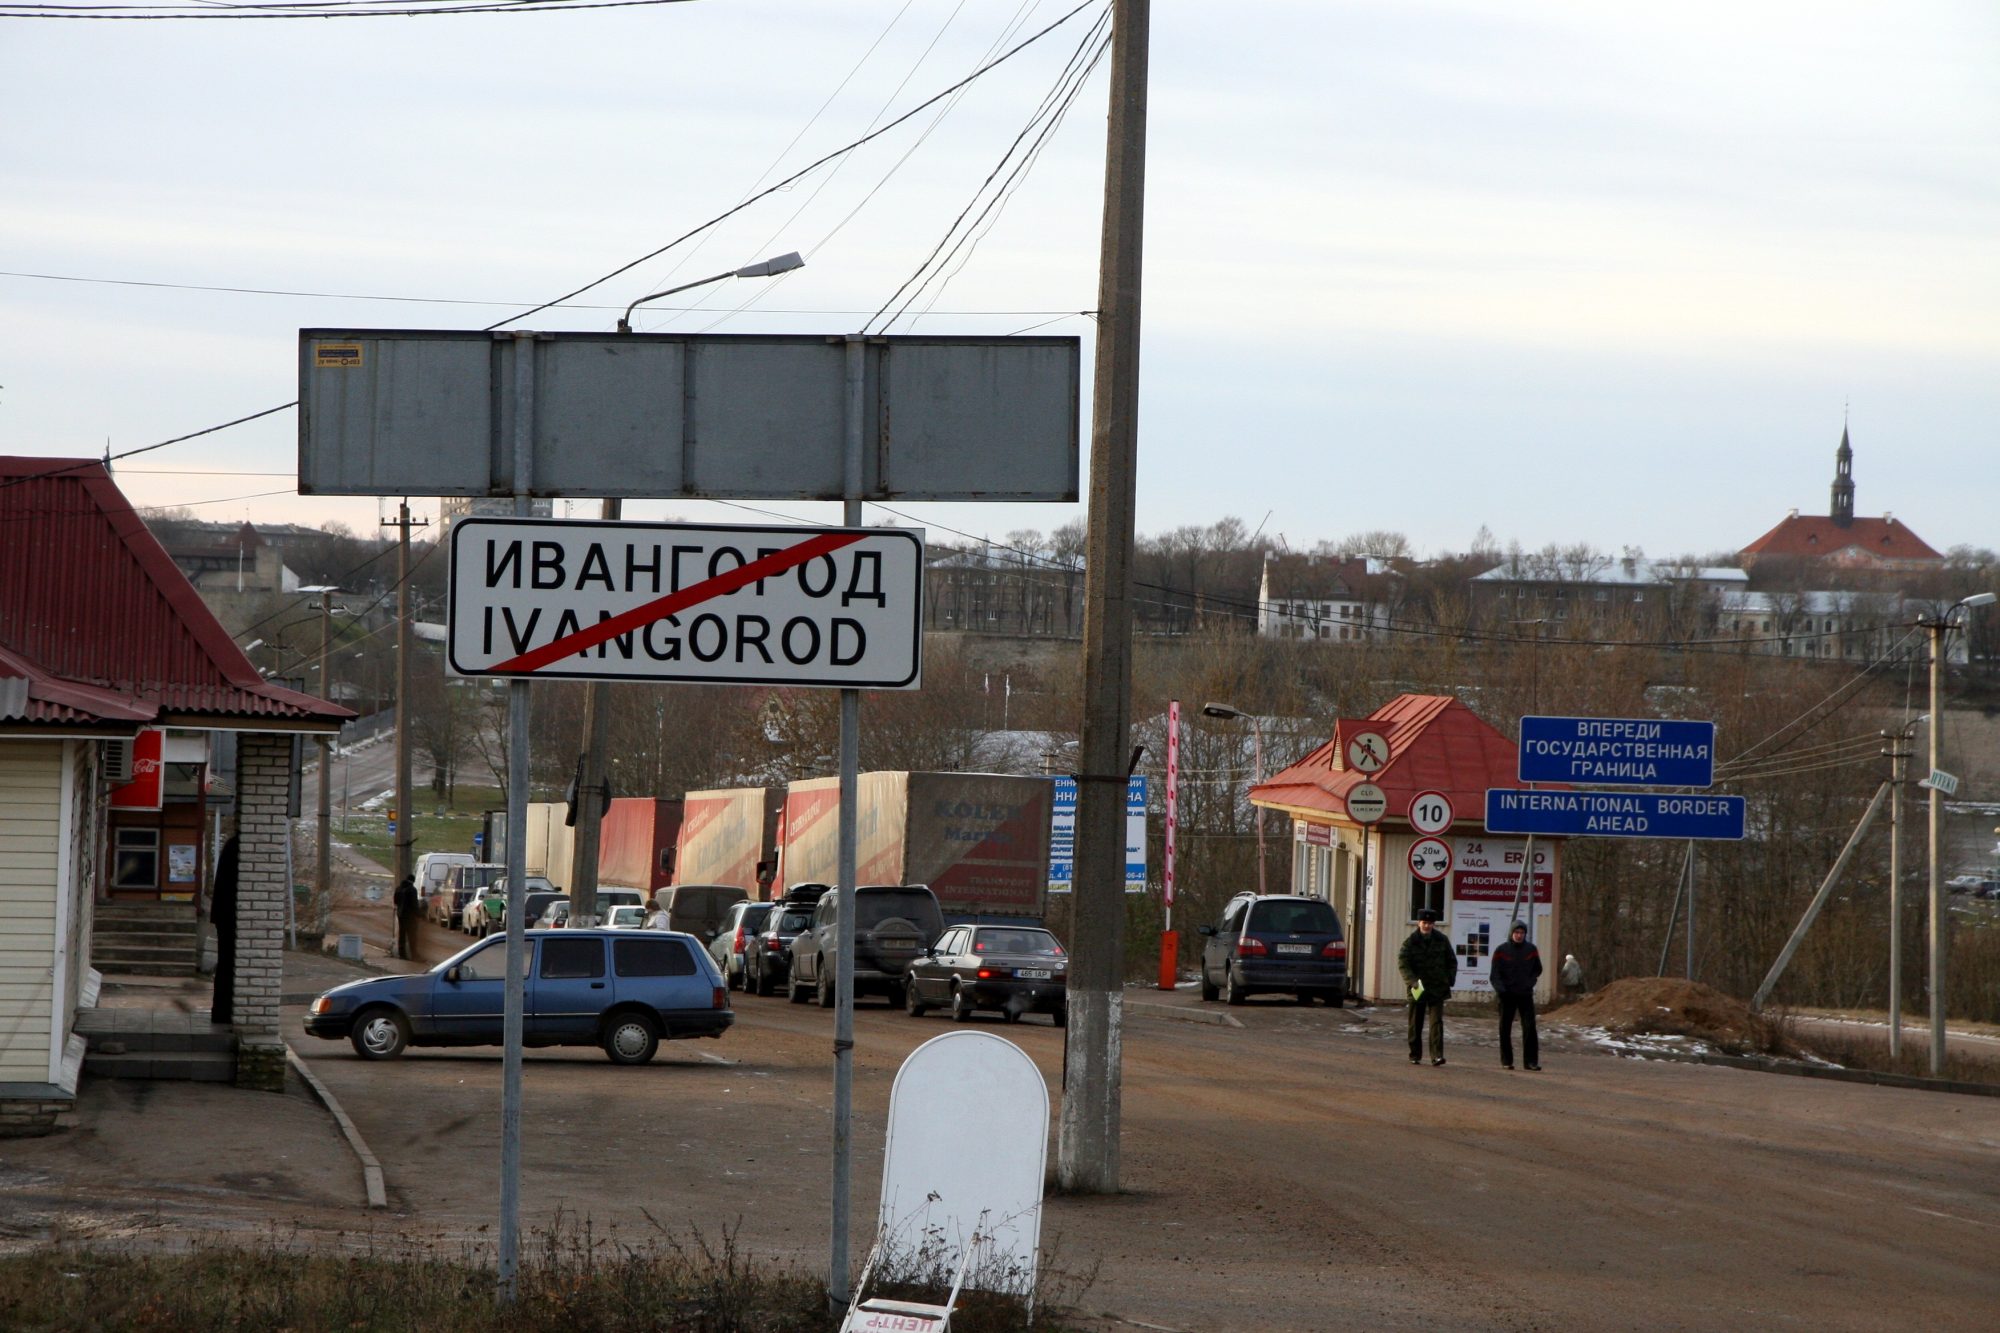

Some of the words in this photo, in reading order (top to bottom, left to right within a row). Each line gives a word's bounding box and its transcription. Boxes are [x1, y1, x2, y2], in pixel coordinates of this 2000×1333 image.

[485, 539, 886, 608] ИВАНГОРОД
[483, 606, 867, 666] IVANGOROD
[1577, 722, 1661, 741] ВПЕРЕДИ
[1526, 740, 1709, 760] ГОСУДАРСТВЕННАЯ
[1571, 761, 1657, 780] ГРАНИЦА
[1419, 803, 1443, 823] 10
[1500, 794, 1645, 814] INTERNATIONAL
[1657, 800, 1730, 816] BORDER
[1586, 816, 1648, 832] AHEAD
[1467, 843, 1483, 854] 24
[1462, 858, 1489, 868] ЧАСА
[1504, 851, 1545, 865] ERO
[944, 885, 1032, 897] INTERNATIONAL
[968, 877, 1033, 887] TRANSPORT
[865, 1315, 934, 1332] ЦЕНТР
